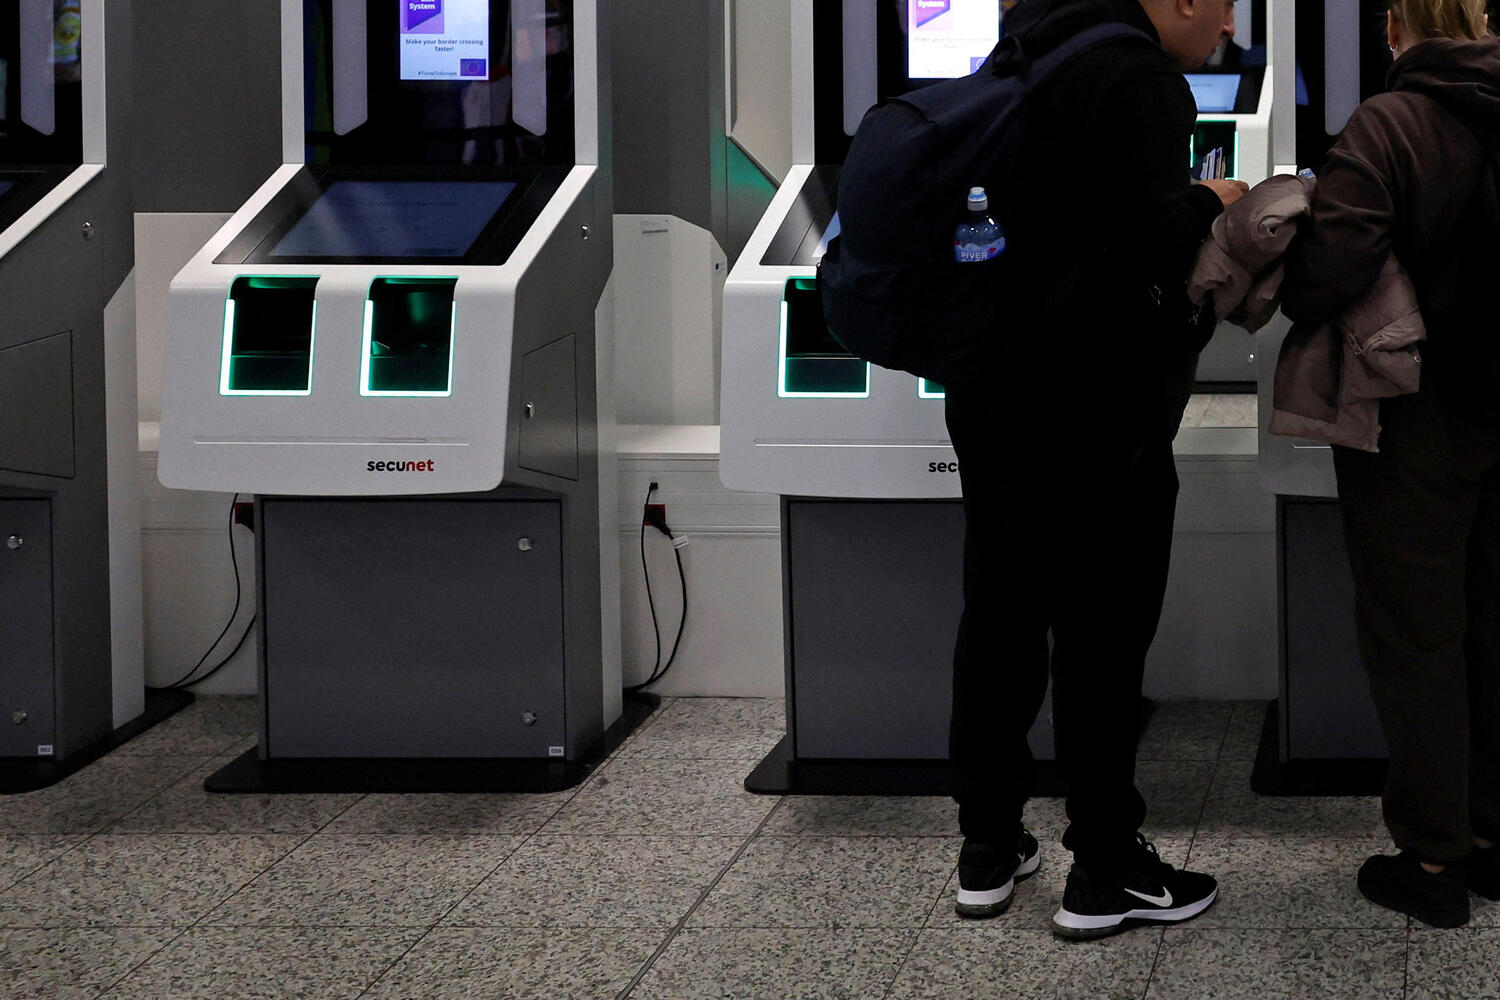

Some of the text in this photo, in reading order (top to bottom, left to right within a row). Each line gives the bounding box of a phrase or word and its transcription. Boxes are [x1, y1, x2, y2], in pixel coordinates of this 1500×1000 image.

[408, 2, 435, 11] System
[961, 251, 988, 259] RIVER
[366, 459, 435, 472] secunet
